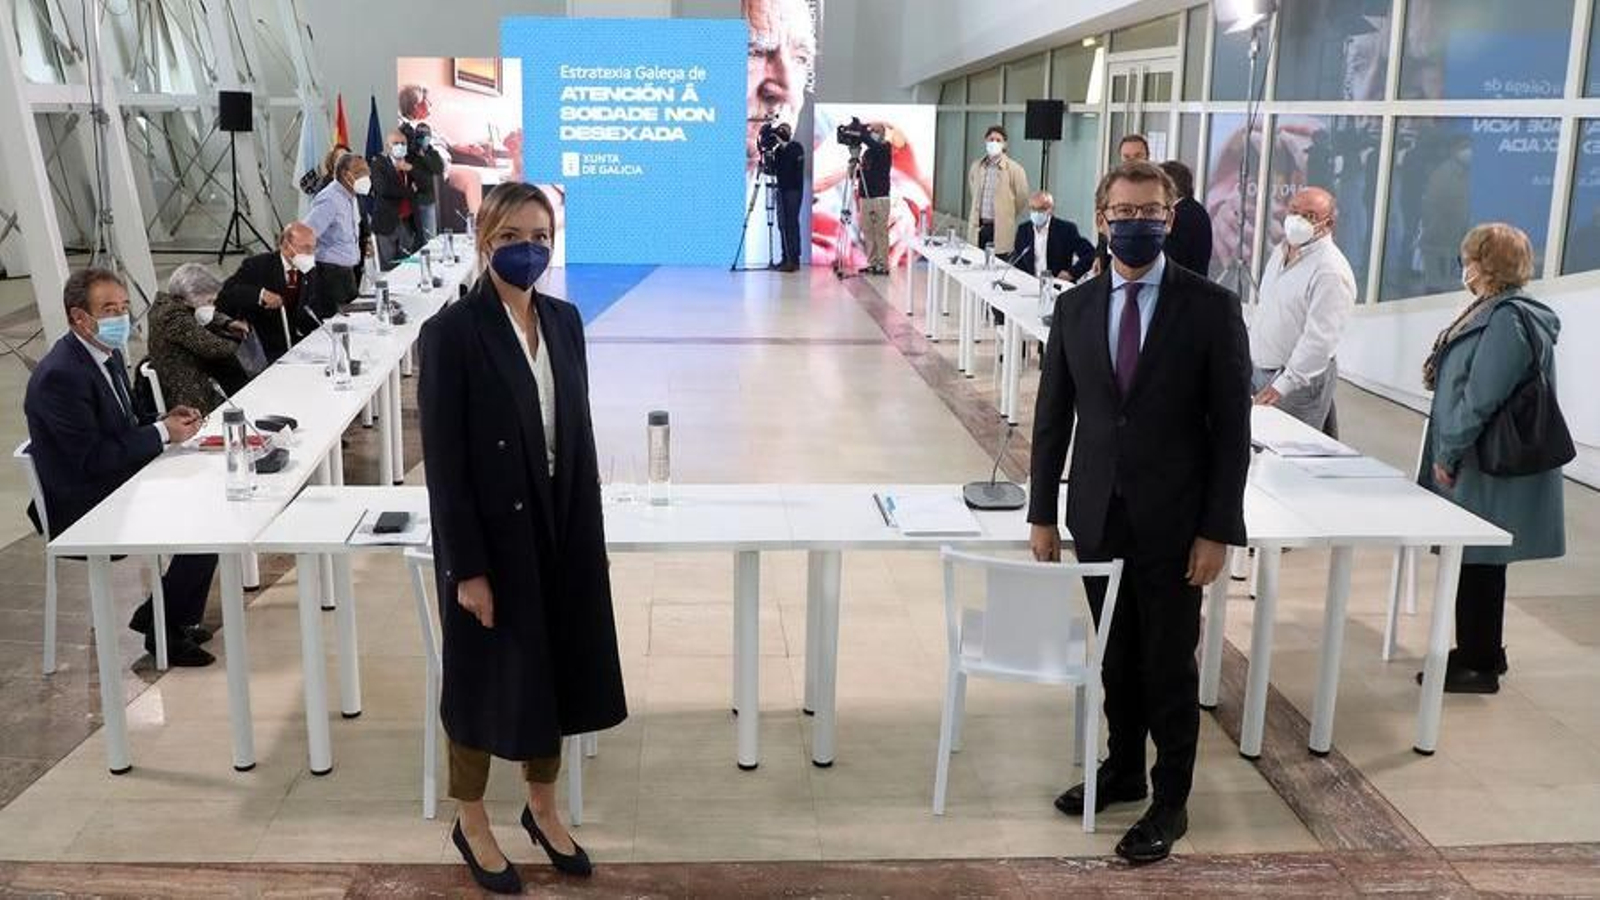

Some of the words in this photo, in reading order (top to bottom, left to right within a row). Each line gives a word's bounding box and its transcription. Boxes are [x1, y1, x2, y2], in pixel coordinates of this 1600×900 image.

[560, 64, 632, 79] Estratexia
[635, 65, 685, 83] Galega
[688, 65, 707, 79] de
[559, 83, 675, 102] ATENCIÓN
[559, 106, 659, 121] SOIDADE
[664, 107, 715, 122] NON
[559, 125, 688, 141] DESEXADA
[583, 153, 620, 164] XUNTA
[582, 165, 597, 175] DE
[598, 165, 644, 175] GALICIA
